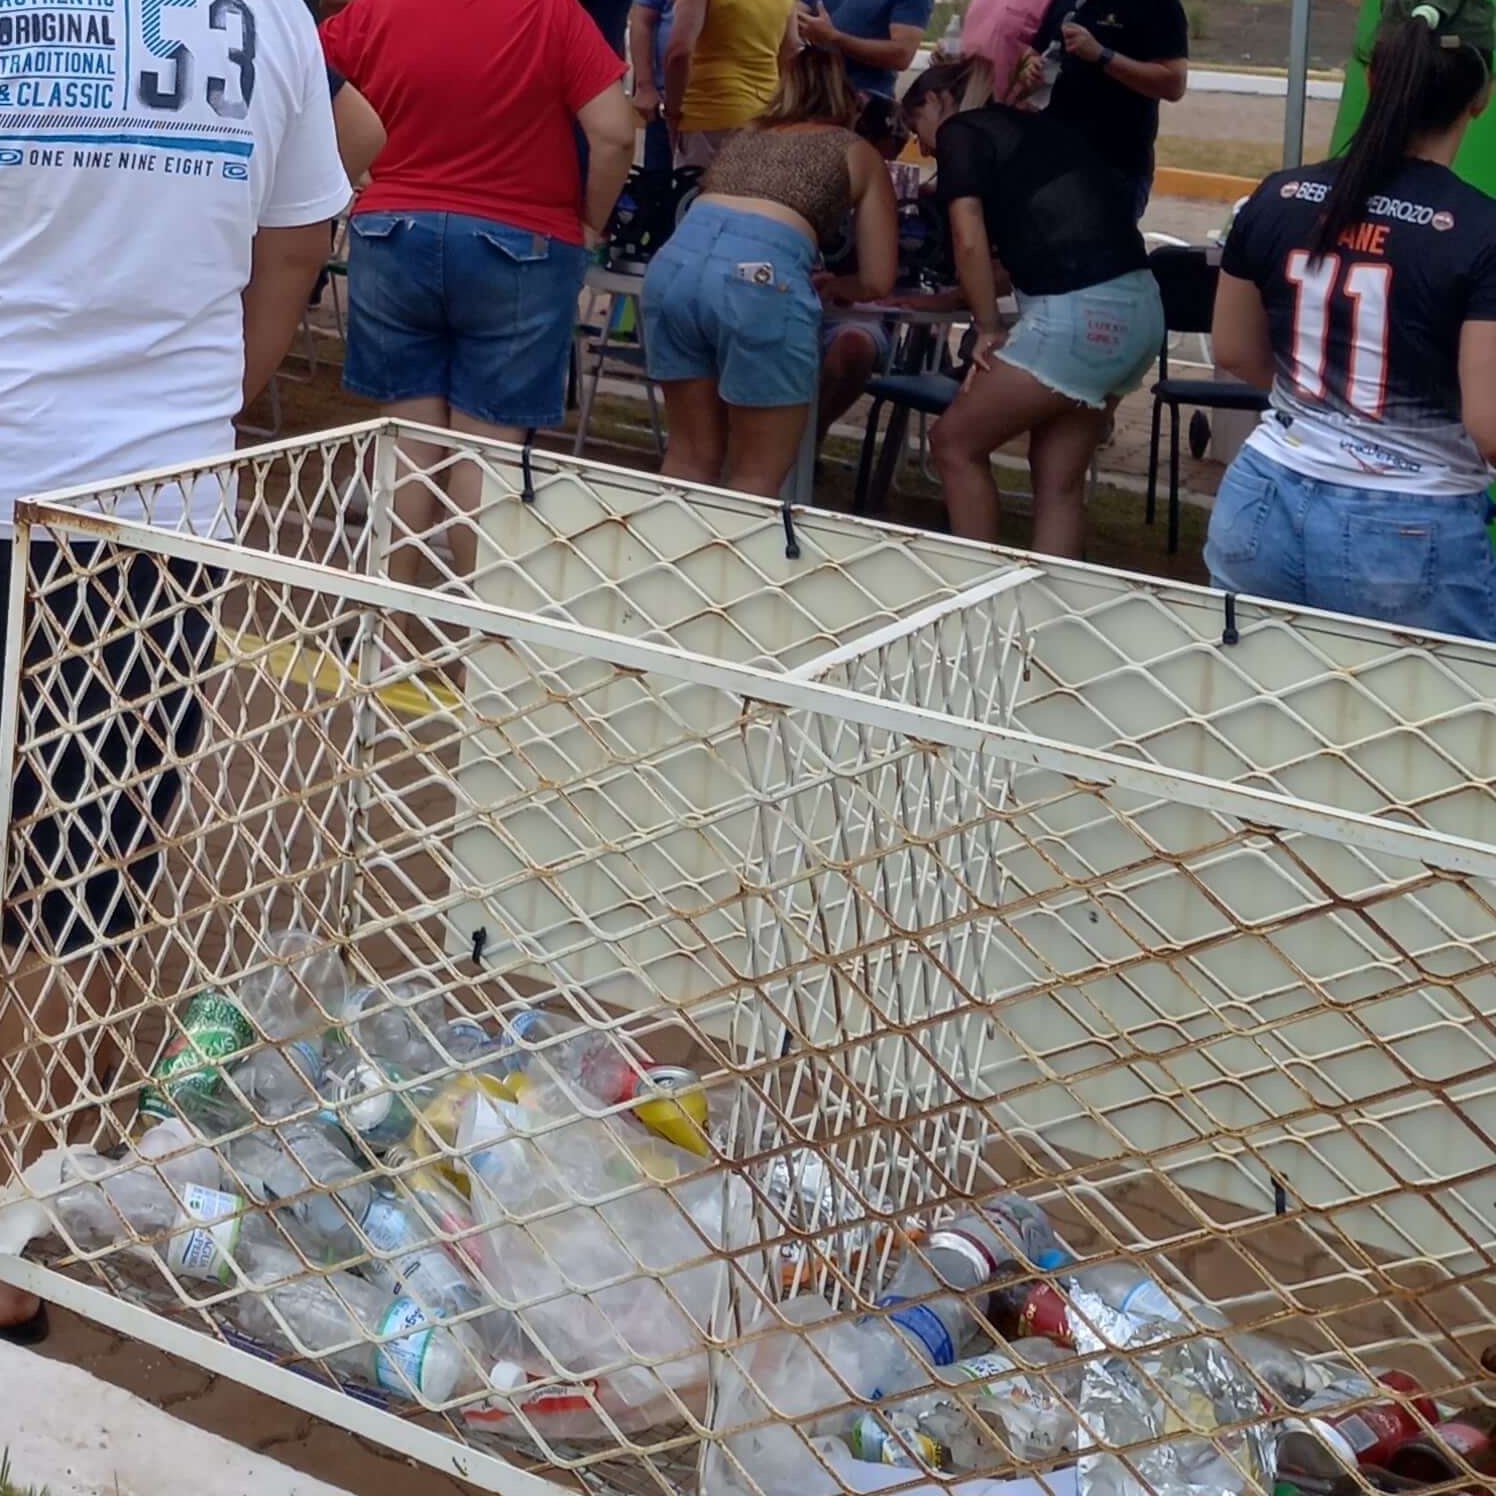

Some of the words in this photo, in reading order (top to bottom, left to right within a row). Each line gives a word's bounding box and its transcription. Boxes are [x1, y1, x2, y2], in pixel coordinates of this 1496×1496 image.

[0, 51, 116, 76] TRADITIONAL
[16, 81, 114, 110] CLASSIC
[29, 149, 65, 169] ONE
[72, 151, 113, 170] NINE
[118, 153, 158, 174] NINE
[162, 157, 215, 178] EIGHT
[1367, 194, 1434, 225] EDROZO
[1283, 248, 1393, 420] 11
